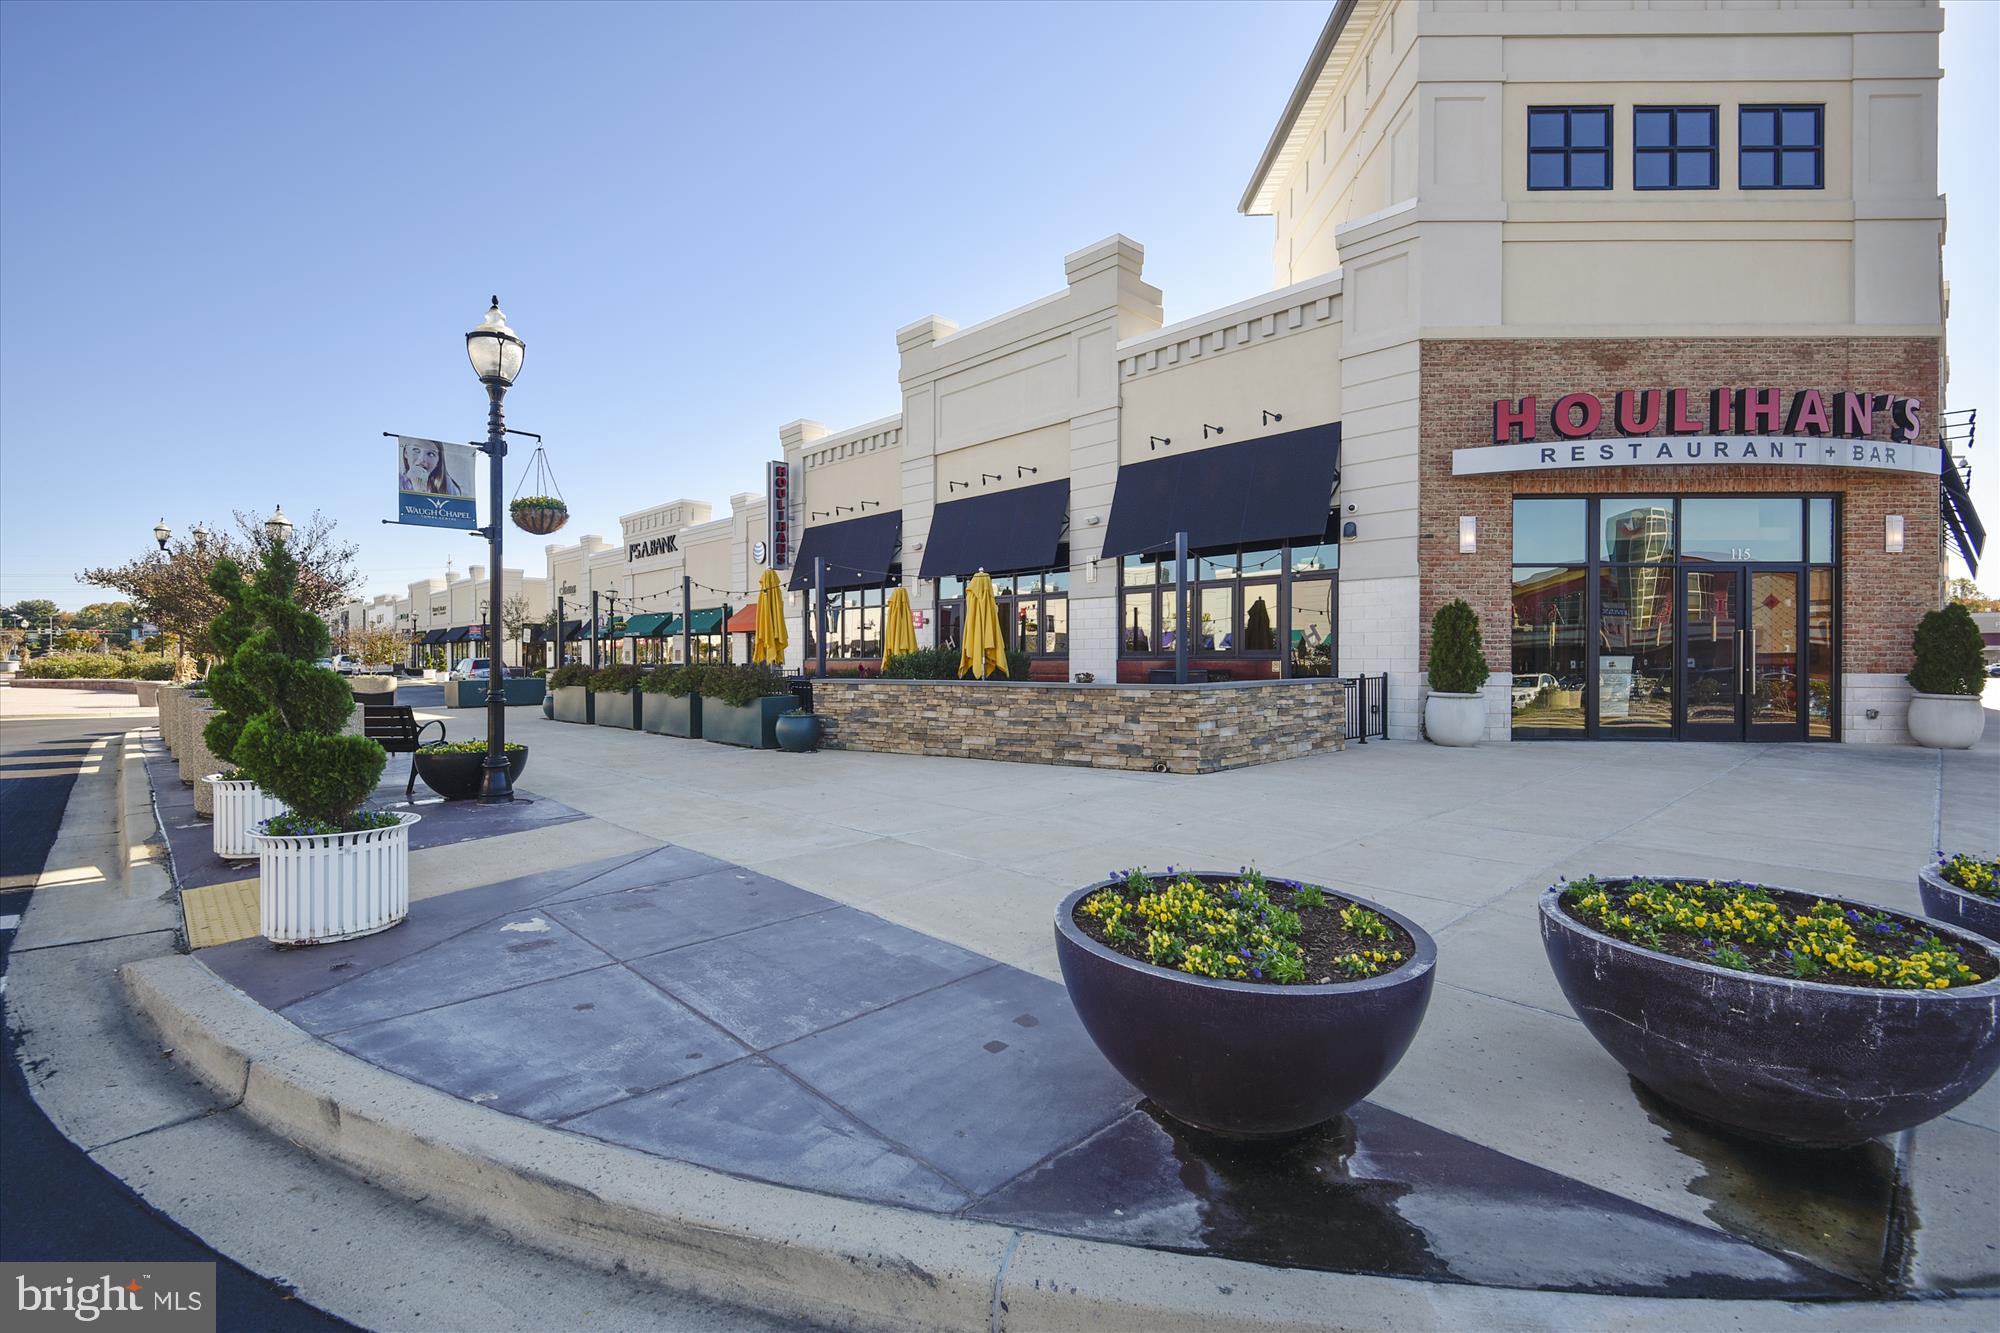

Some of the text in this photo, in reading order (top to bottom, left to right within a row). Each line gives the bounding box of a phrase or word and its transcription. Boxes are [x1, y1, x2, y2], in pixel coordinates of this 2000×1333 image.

[1492, 388, 1922, 444] HOULIHAN'S
[1541, 441, 1807, 464] RESTAURANT
[1853, 444, 1897, 464] BAR
[405, 505, 472, 519] WAUGH CHAPEL
[1730, 547, 1752, 560] 115
